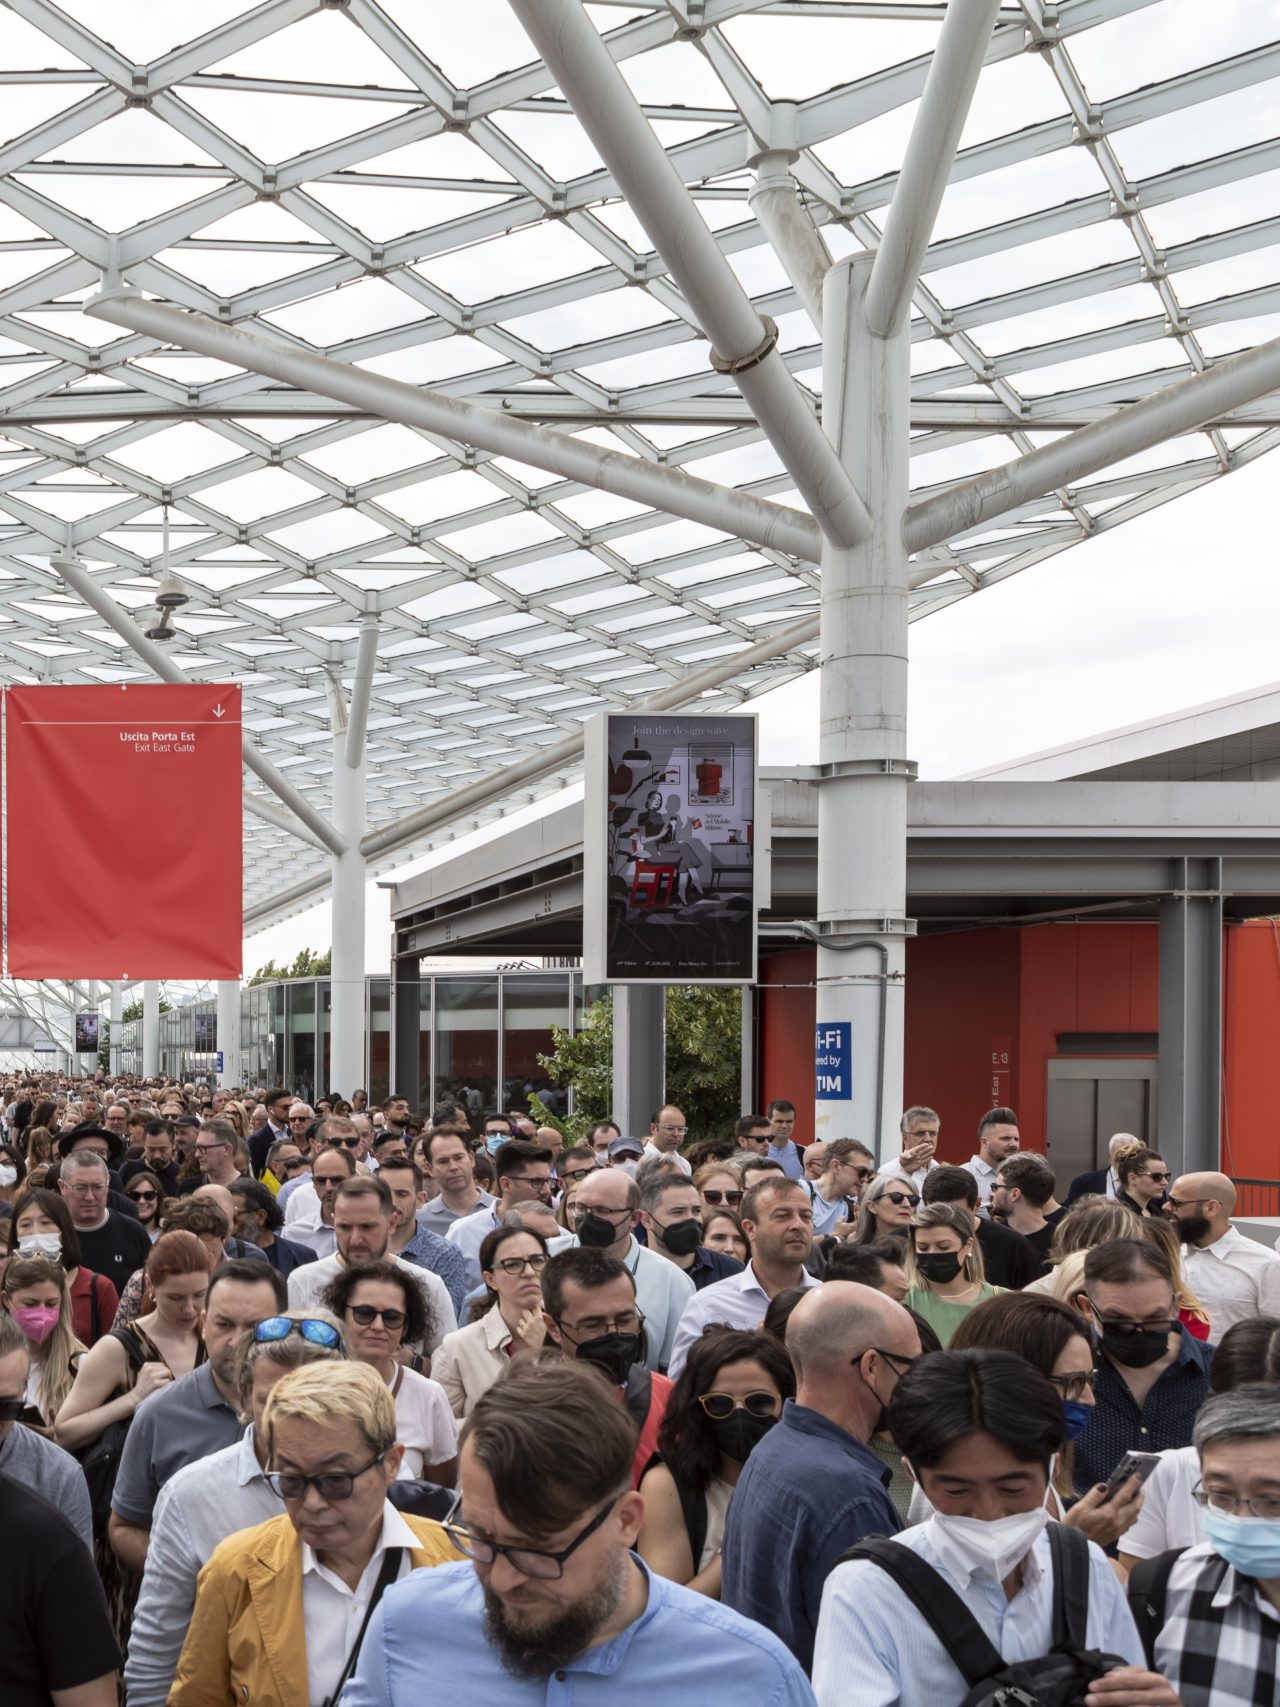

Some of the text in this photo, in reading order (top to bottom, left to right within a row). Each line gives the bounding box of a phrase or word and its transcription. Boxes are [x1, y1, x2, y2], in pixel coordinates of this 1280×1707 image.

[632, 724, 729, 736] Join the design wave
[120, 732, 196, 742] Uscita Porta Est
[135, 743, 196, 753] Exit East Gate
[816, 1030, 841, 1049] i-Fi
[829, 1055, 841, 1067] by
[816, 1075, 842, 1092] TIM
